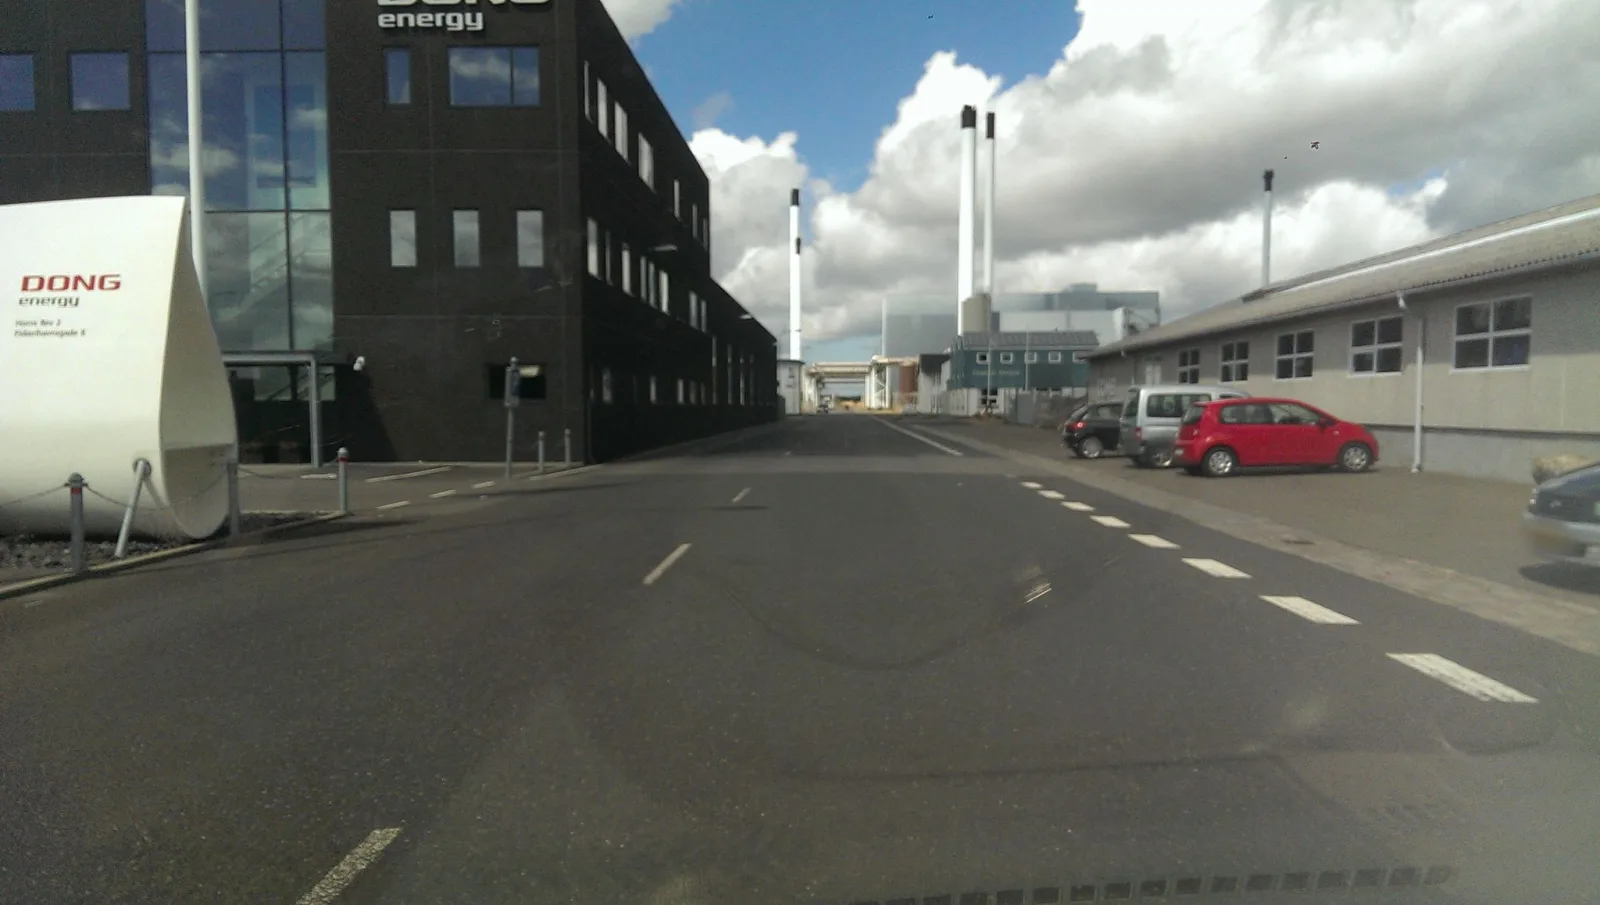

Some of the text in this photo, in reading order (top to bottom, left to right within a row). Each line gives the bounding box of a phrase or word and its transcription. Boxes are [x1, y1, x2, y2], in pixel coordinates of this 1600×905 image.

[377, 12, 484, 32] energy
[21, 274, 121, 292] DONG
[18, 296, 80, 307] energy
